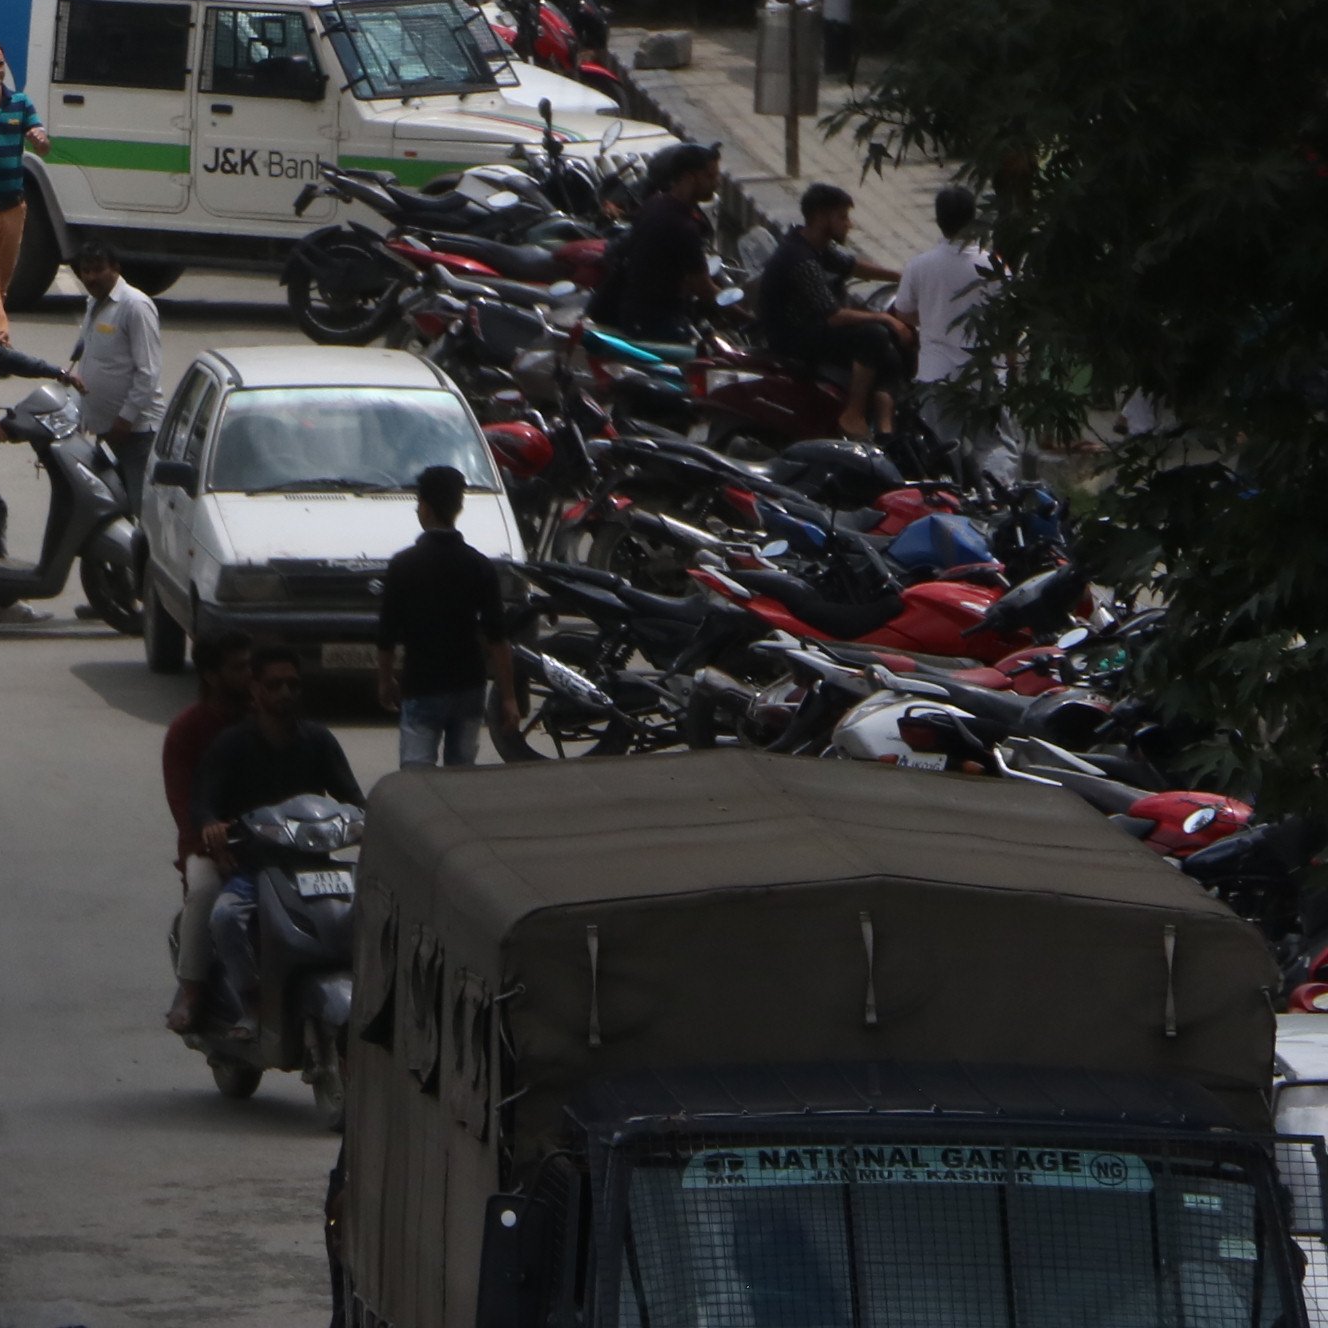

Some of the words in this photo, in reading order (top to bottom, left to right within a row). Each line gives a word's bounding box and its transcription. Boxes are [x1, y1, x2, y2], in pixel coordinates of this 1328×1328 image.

[203, 147, 259, 176] J&K
[758, 1148, 929, 1170] NATIONAL
[941, 1149, 1082, 1173] GARAGE
[705, 1174, 745, 1184] TATA
[903, 1171, 917, 1180] &
[926, 1170, 1033, 1183] KASHMR
[1095, 1161, 1123, 1179] NG
